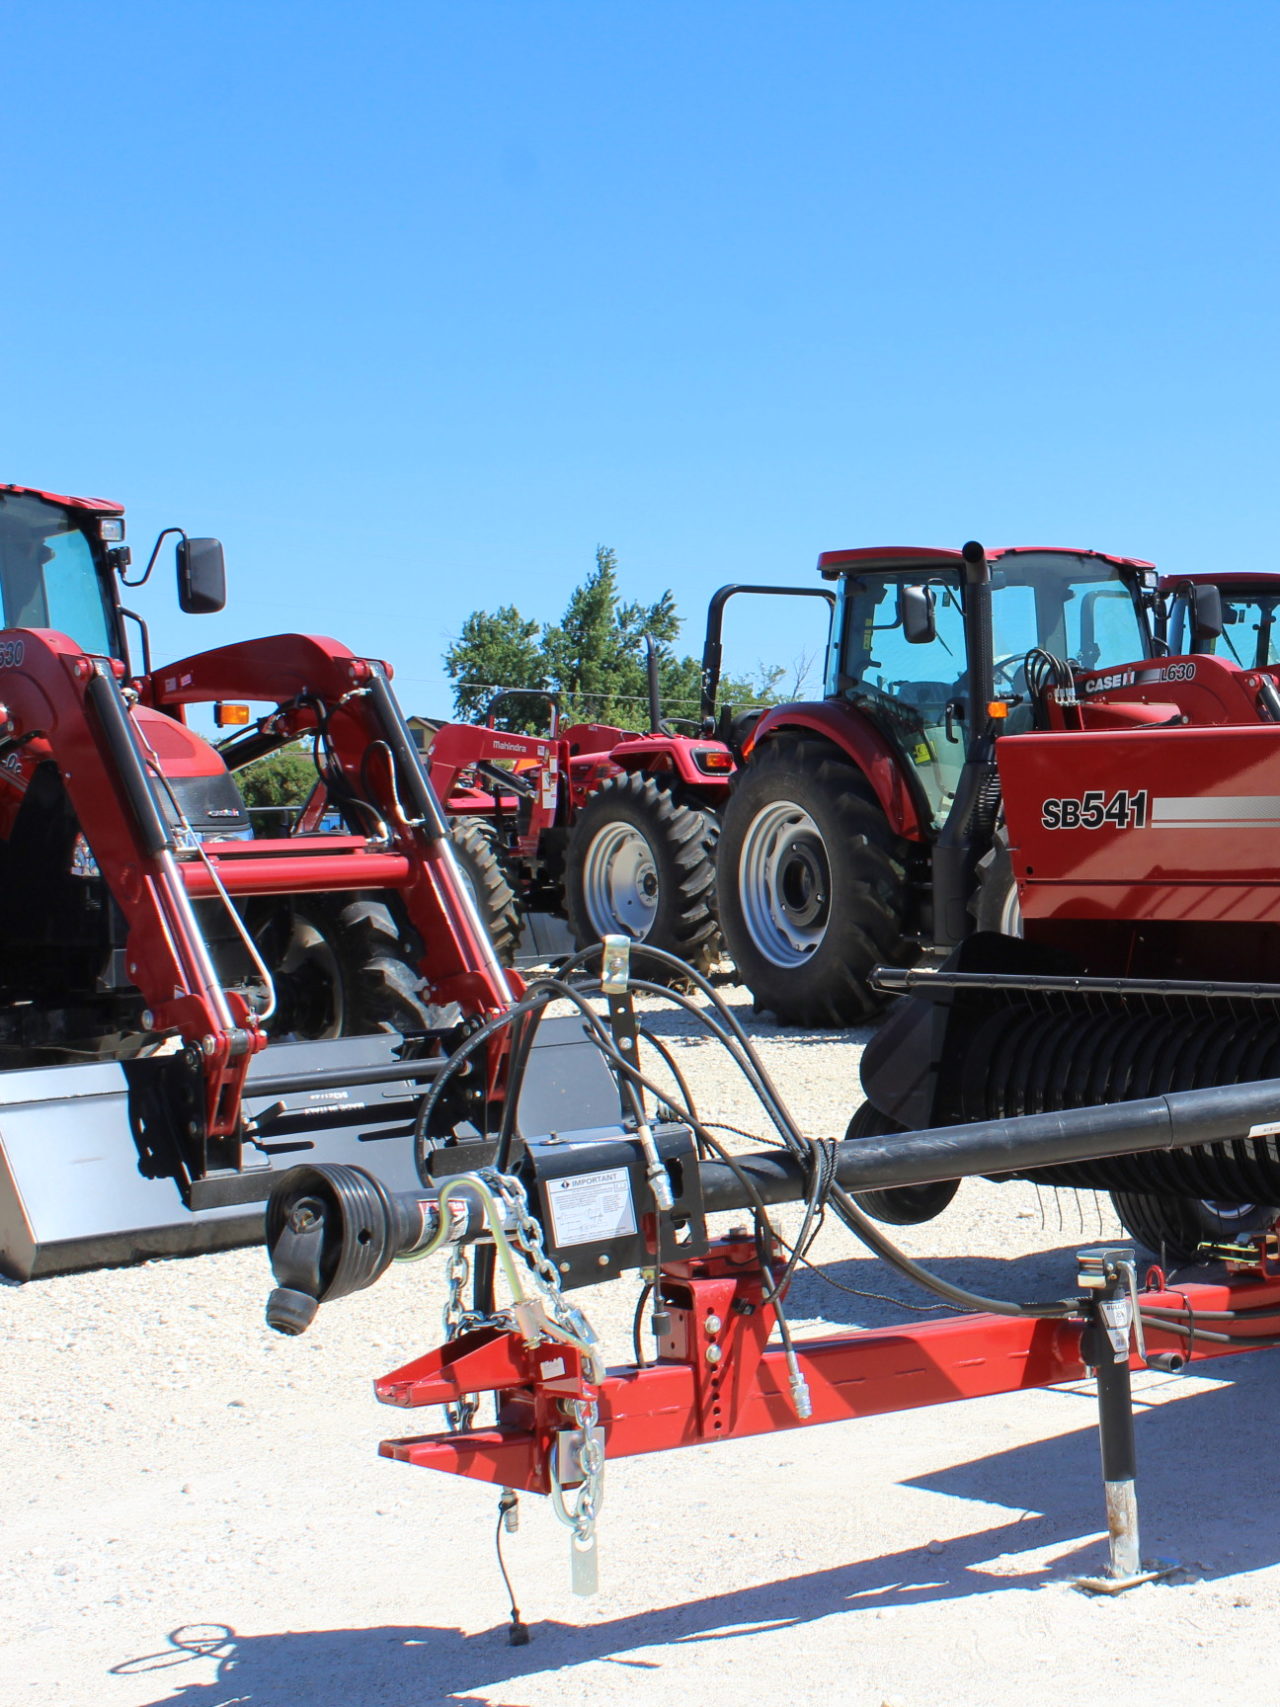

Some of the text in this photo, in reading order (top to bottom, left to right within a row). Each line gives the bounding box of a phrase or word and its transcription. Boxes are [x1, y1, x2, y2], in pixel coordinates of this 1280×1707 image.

[1085, 674, 1122, 693] CASE
[1160, 662, 1197, 682] L630
[493, 740, 527, 753] Mahindra
[1041, 789, 1148, 830] SB541
[572, 1173, 617, 1187] IMPORTANT
